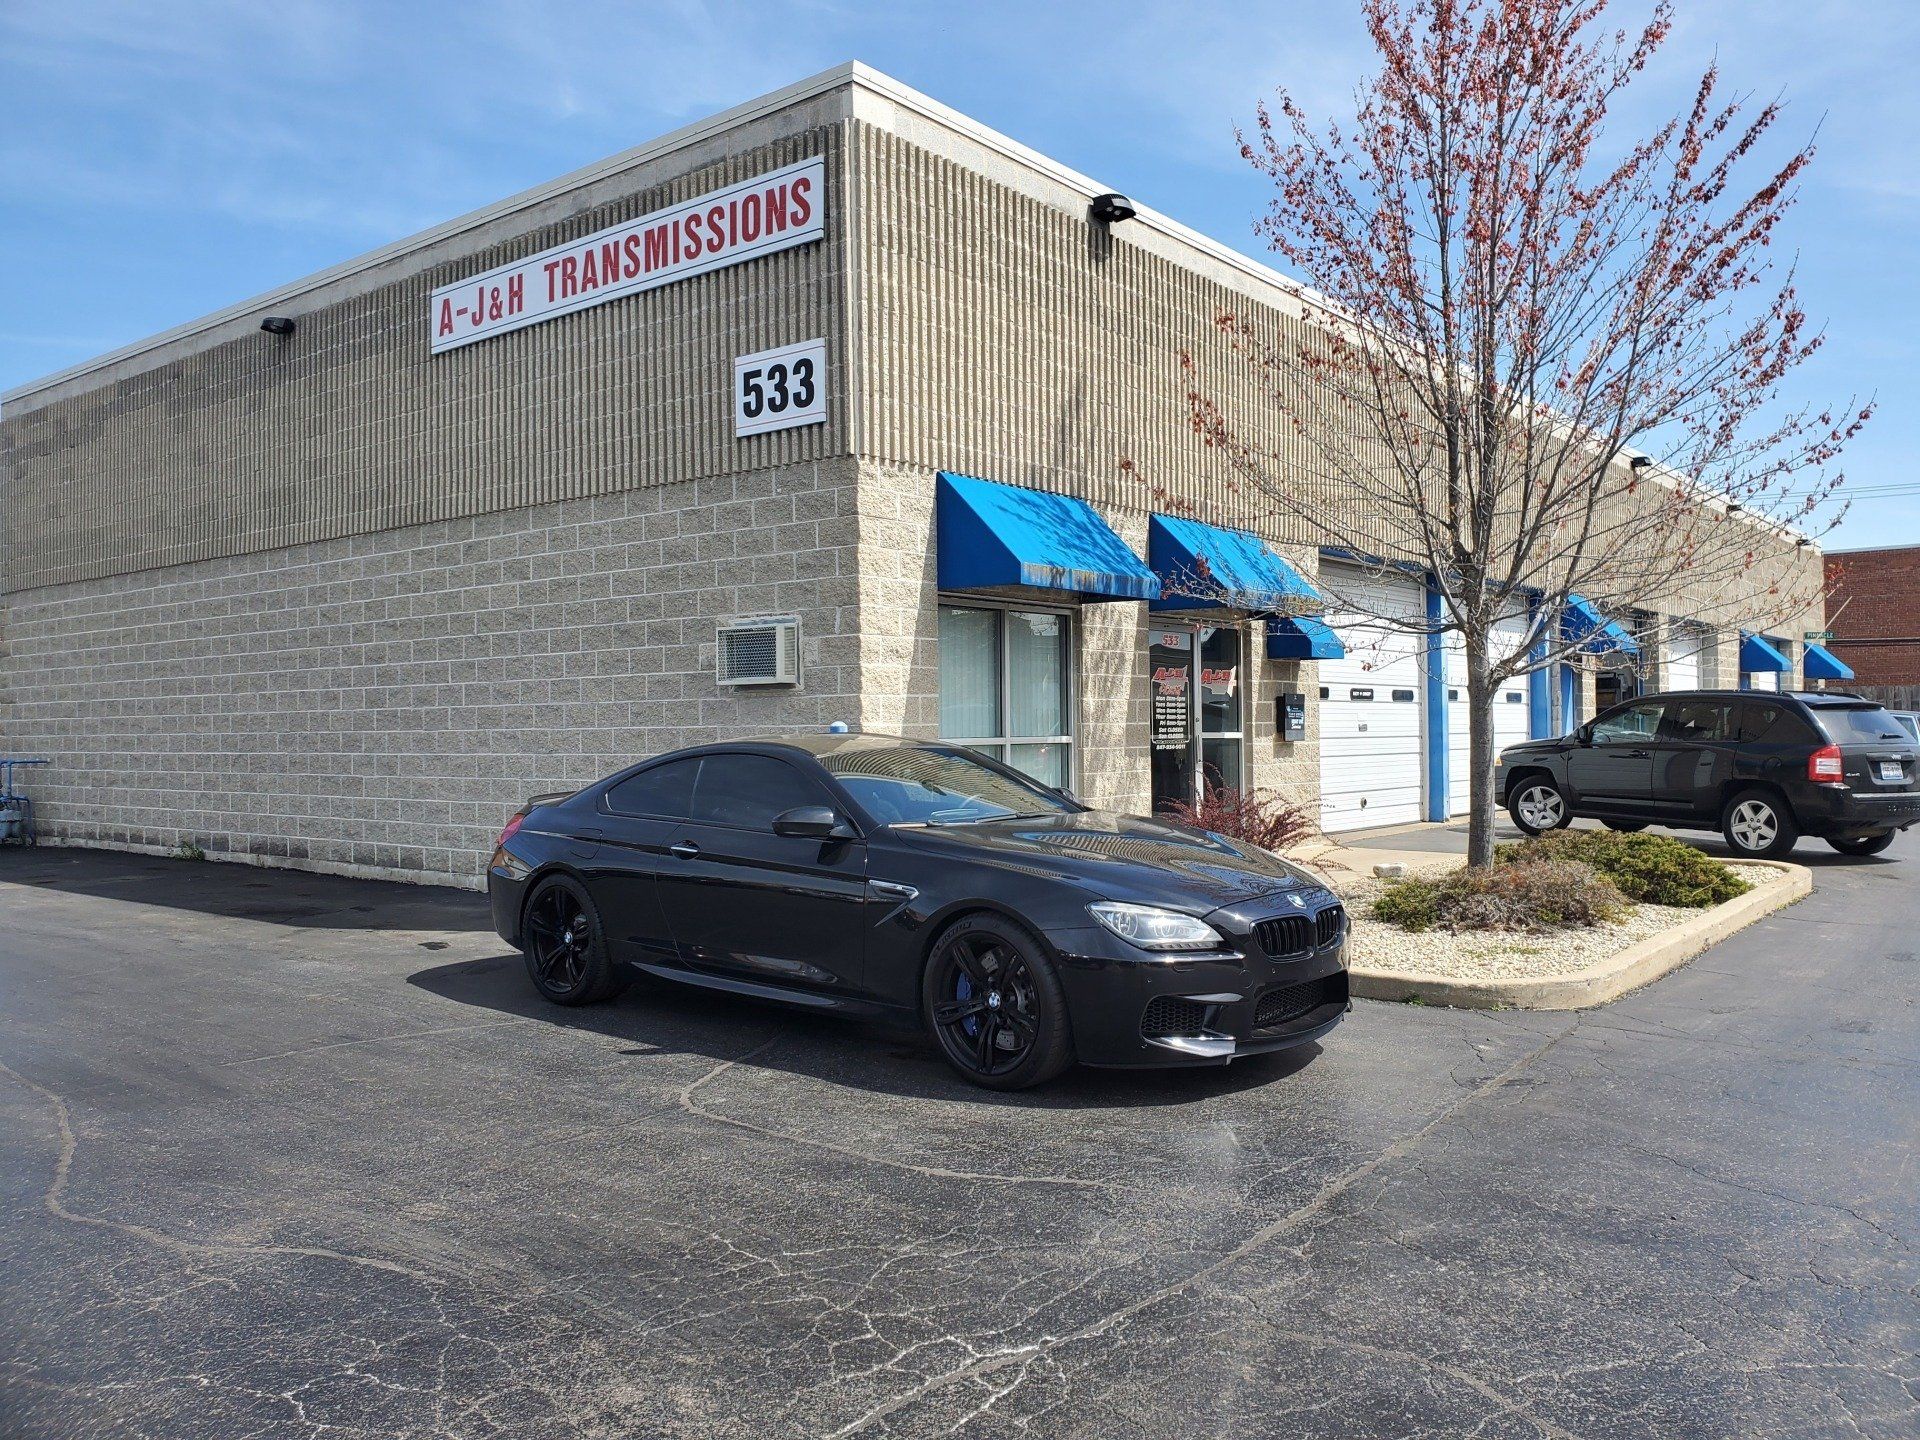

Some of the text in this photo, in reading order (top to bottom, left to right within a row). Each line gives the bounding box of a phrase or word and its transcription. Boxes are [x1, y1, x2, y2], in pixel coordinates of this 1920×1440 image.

[438, 177, 811, 337] A-J&H TRANSMISSIONS
[743, 357, 815, 418] 533
[1162, 634, 1180, 646] 533
